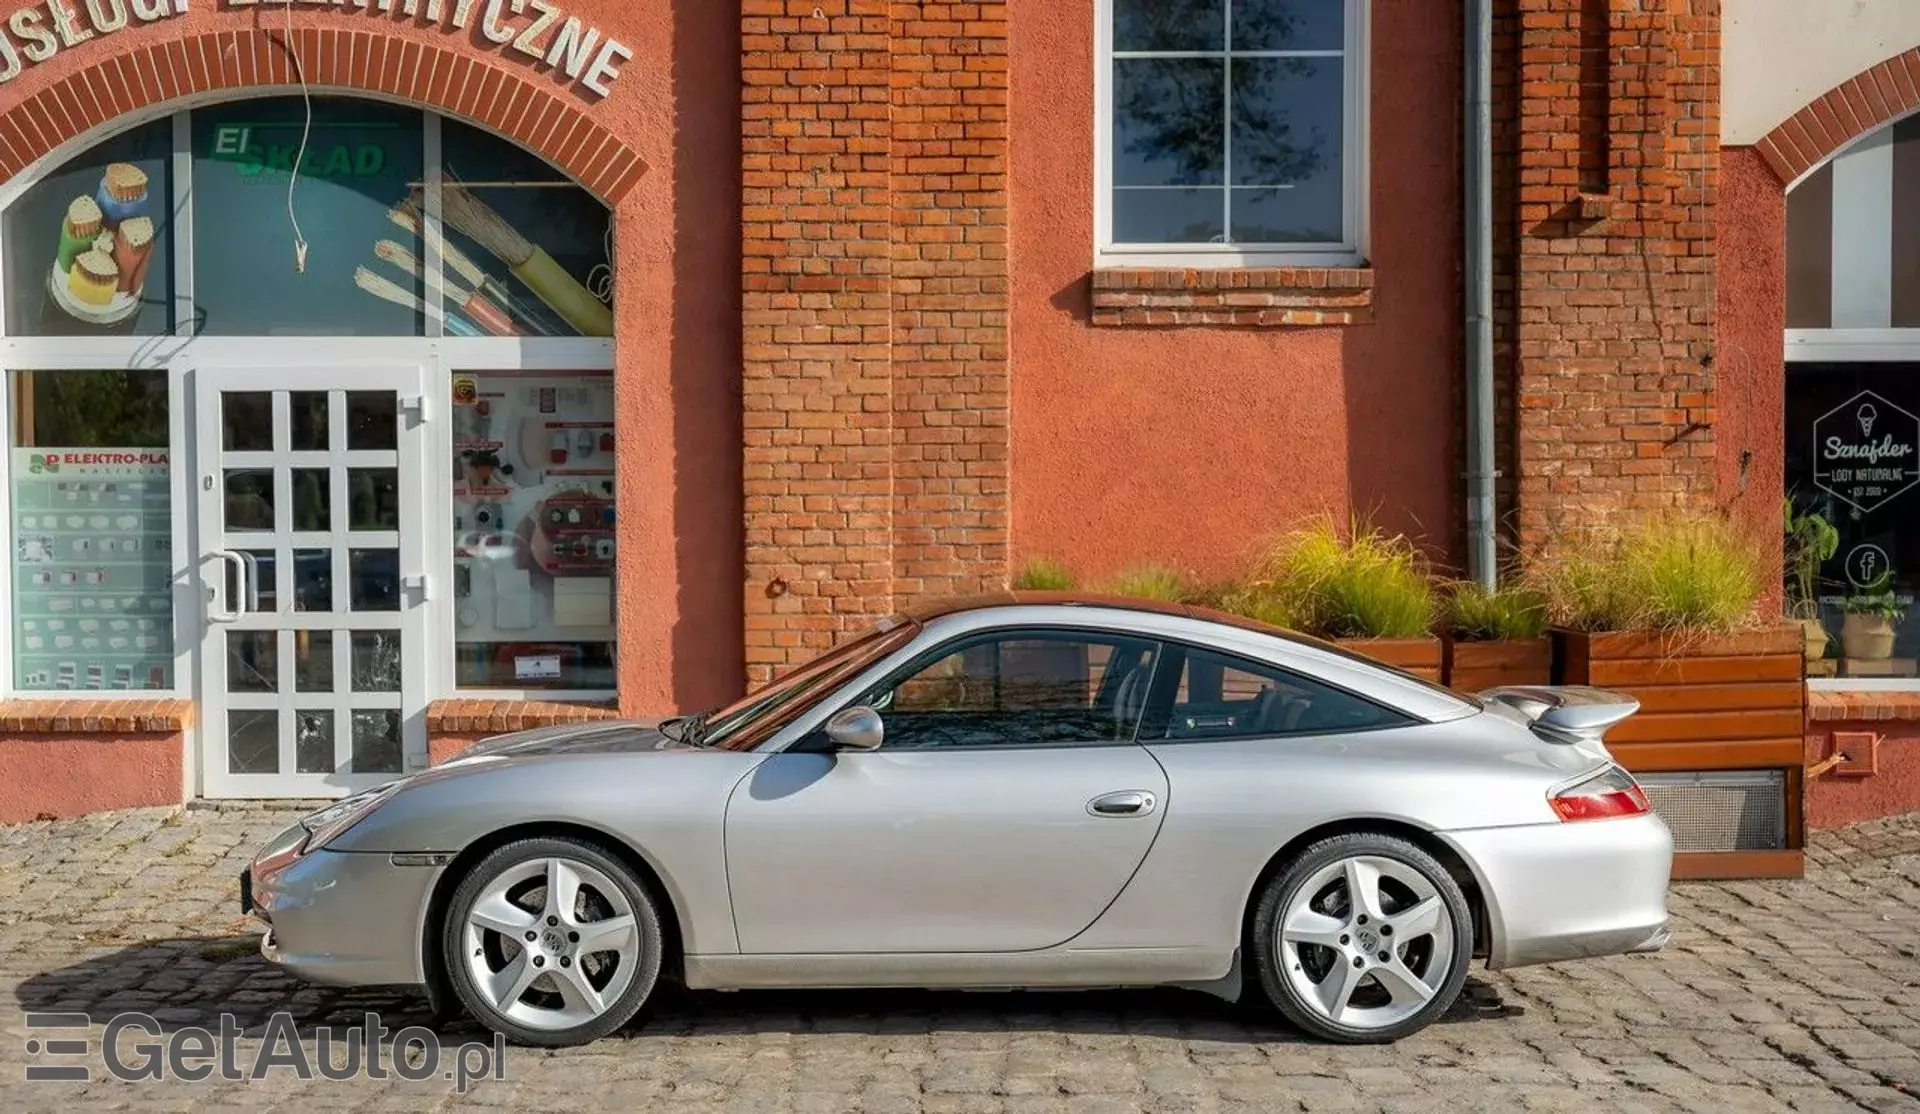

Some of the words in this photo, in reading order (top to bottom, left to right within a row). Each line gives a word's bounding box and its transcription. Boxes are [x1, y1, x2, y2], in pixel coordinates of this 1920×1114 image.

[0, 0, 188, 83] SŁU
[1824, 433, 1913, 464] Sznajder
[1831, 469, 1853, 482] LODY
[1856, 468, 1903, 481] NATURALNE
